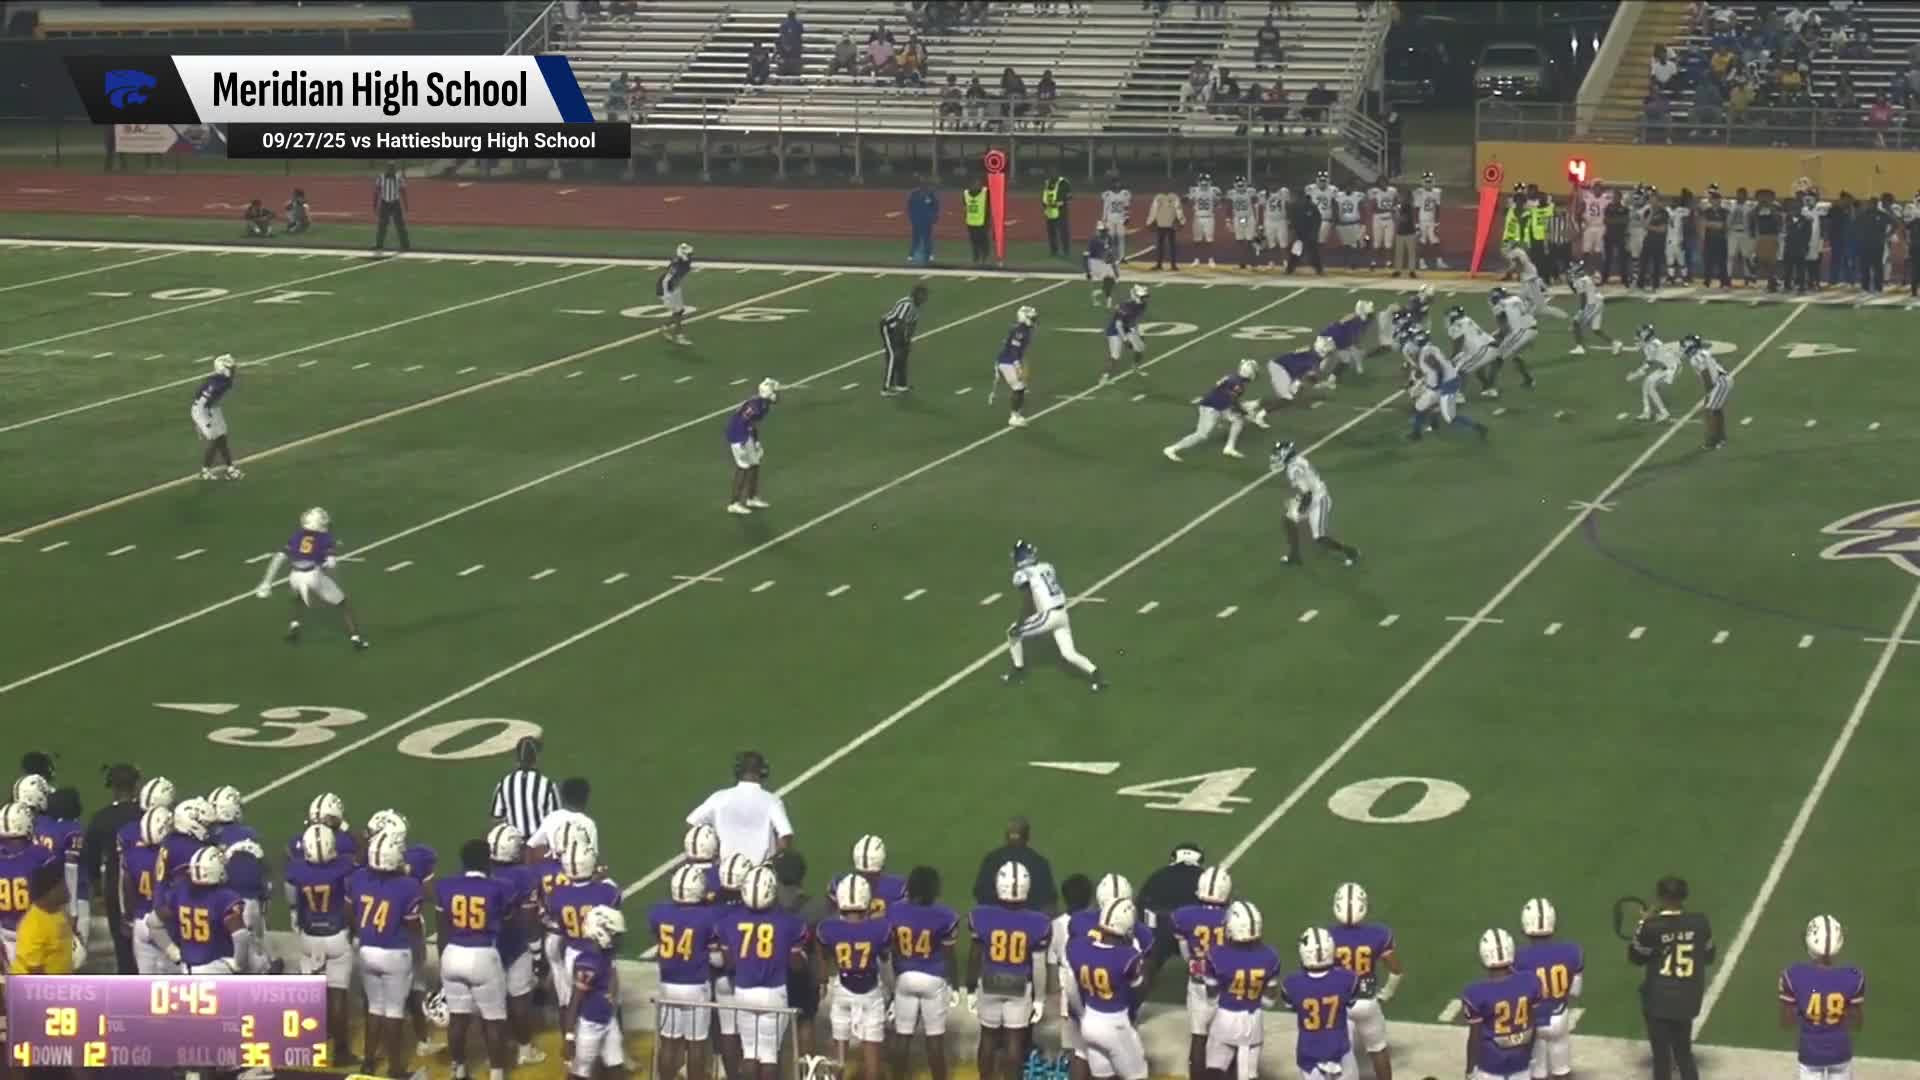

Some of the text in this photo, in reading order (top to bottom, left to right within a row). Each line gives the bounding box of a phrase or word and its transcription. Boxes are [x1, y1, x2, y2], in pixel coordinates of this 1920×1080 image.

[1569, 160, 1586, 182] 4
[300, 536, 315, 553] 6
[0, 877, 30, 911] 96
[303, 885, 331, 912] 17
[179, 905, 210, 941] 55
[360, 896, 390, 932] 74
[451, 895, 485, 928] 95
[659, 924, 693, 961] 54
[737, 923, 774, 958] 78
[836, 943, 871, 969] 87
[897, 926, 931, 959] 84
[990, 930, 1027, 963] 80
[1194, 925, 1225, 957] 31
[1336, 945, 1372, 977] 36
[1659, 943, 1695, 977] 15
[1229, 969, 1265, 1000] 45
[1536, 963, 1569, 998] 10
[1303, 996, 1340, 1030] 37
[1494, 996, 1528, 1034] 24
[1807, 992, 1844, 1024] 48
